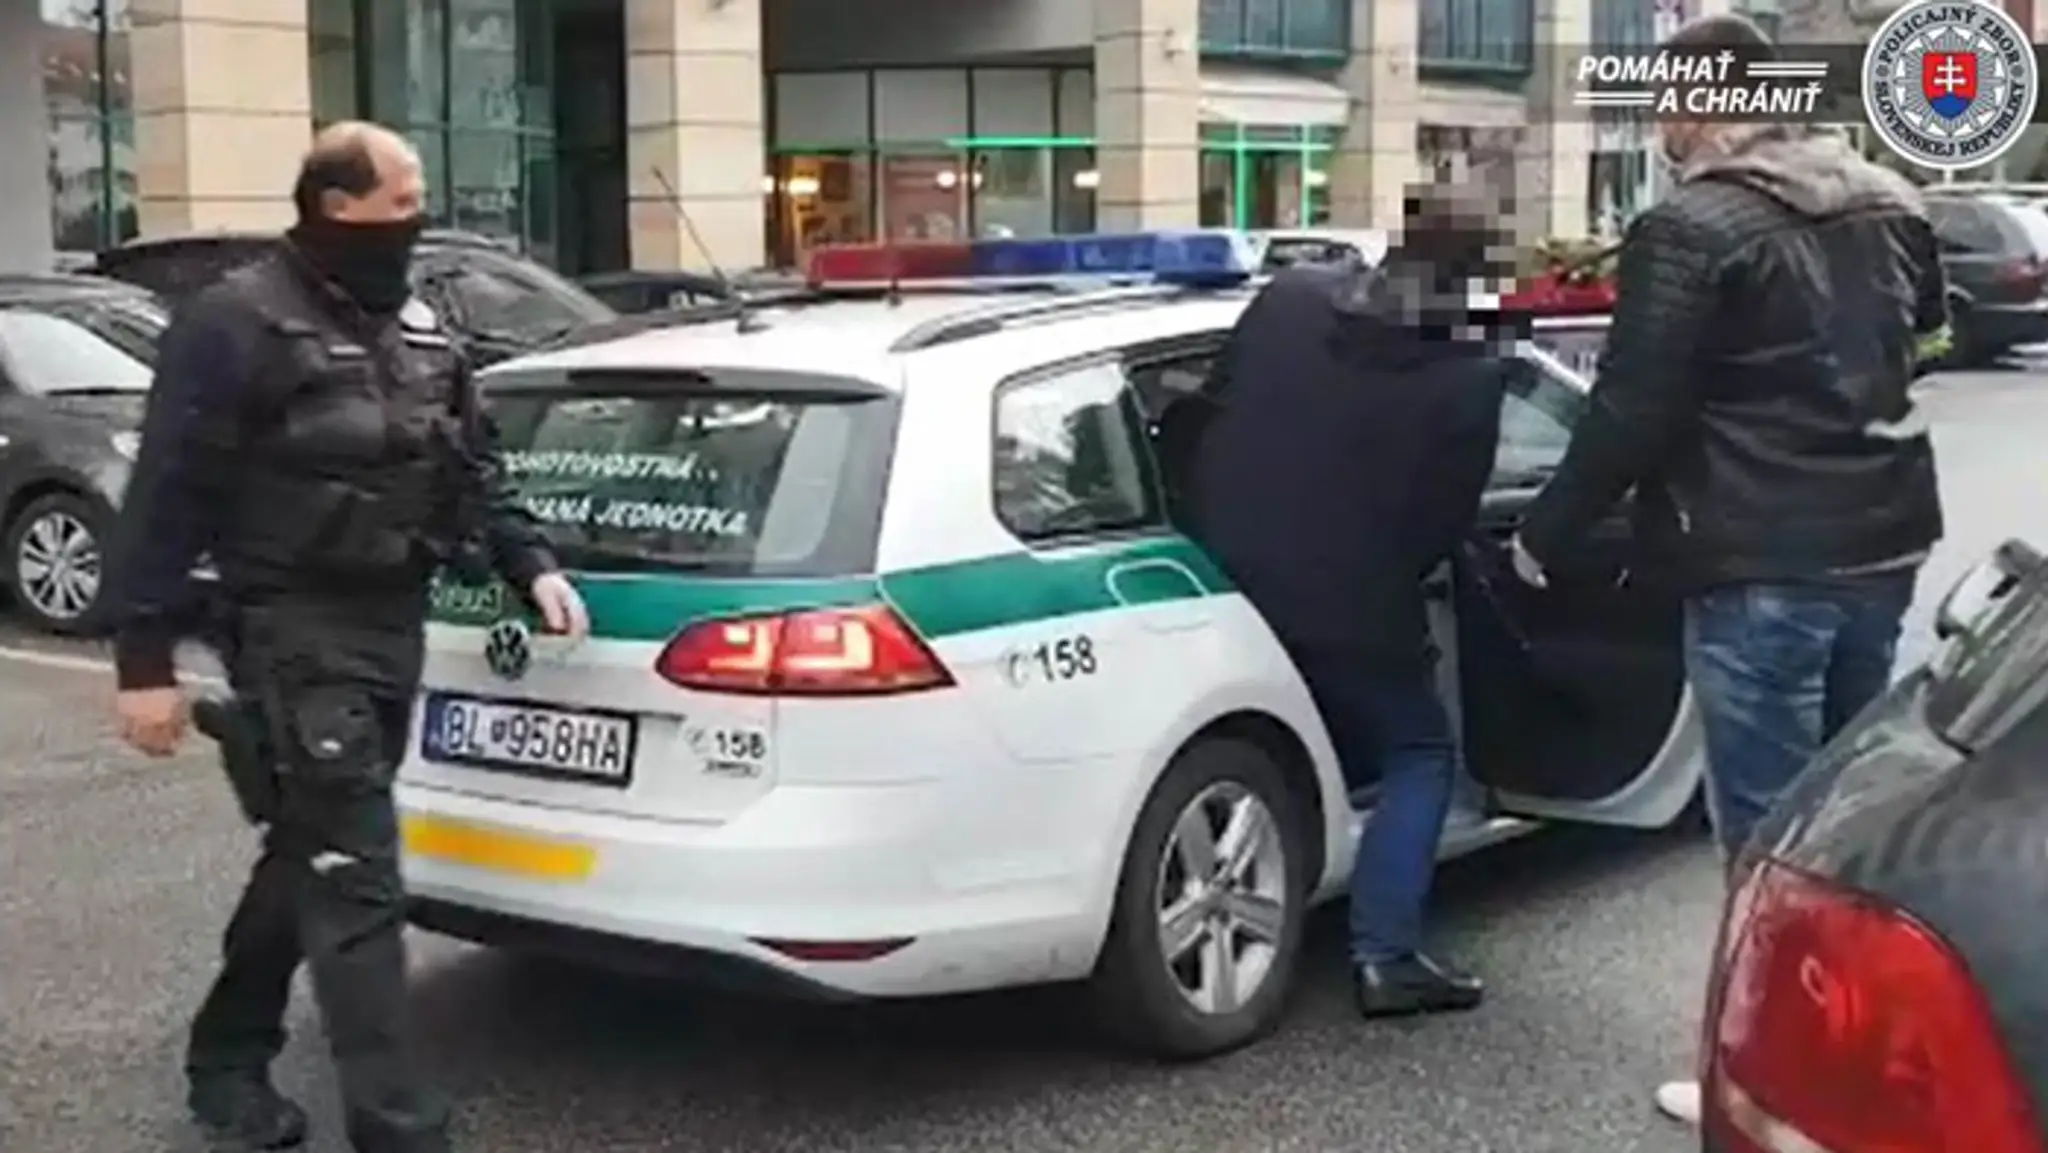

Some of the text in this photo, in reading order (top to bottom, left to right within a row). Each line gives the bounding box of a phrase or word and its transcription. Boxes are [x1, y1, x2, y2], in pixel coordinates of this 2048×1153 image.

[594, 498, 749, 537] JEDNOTKA
[1032, 633, 1098, 682] 158
[715, 729, 767, 759] 158
